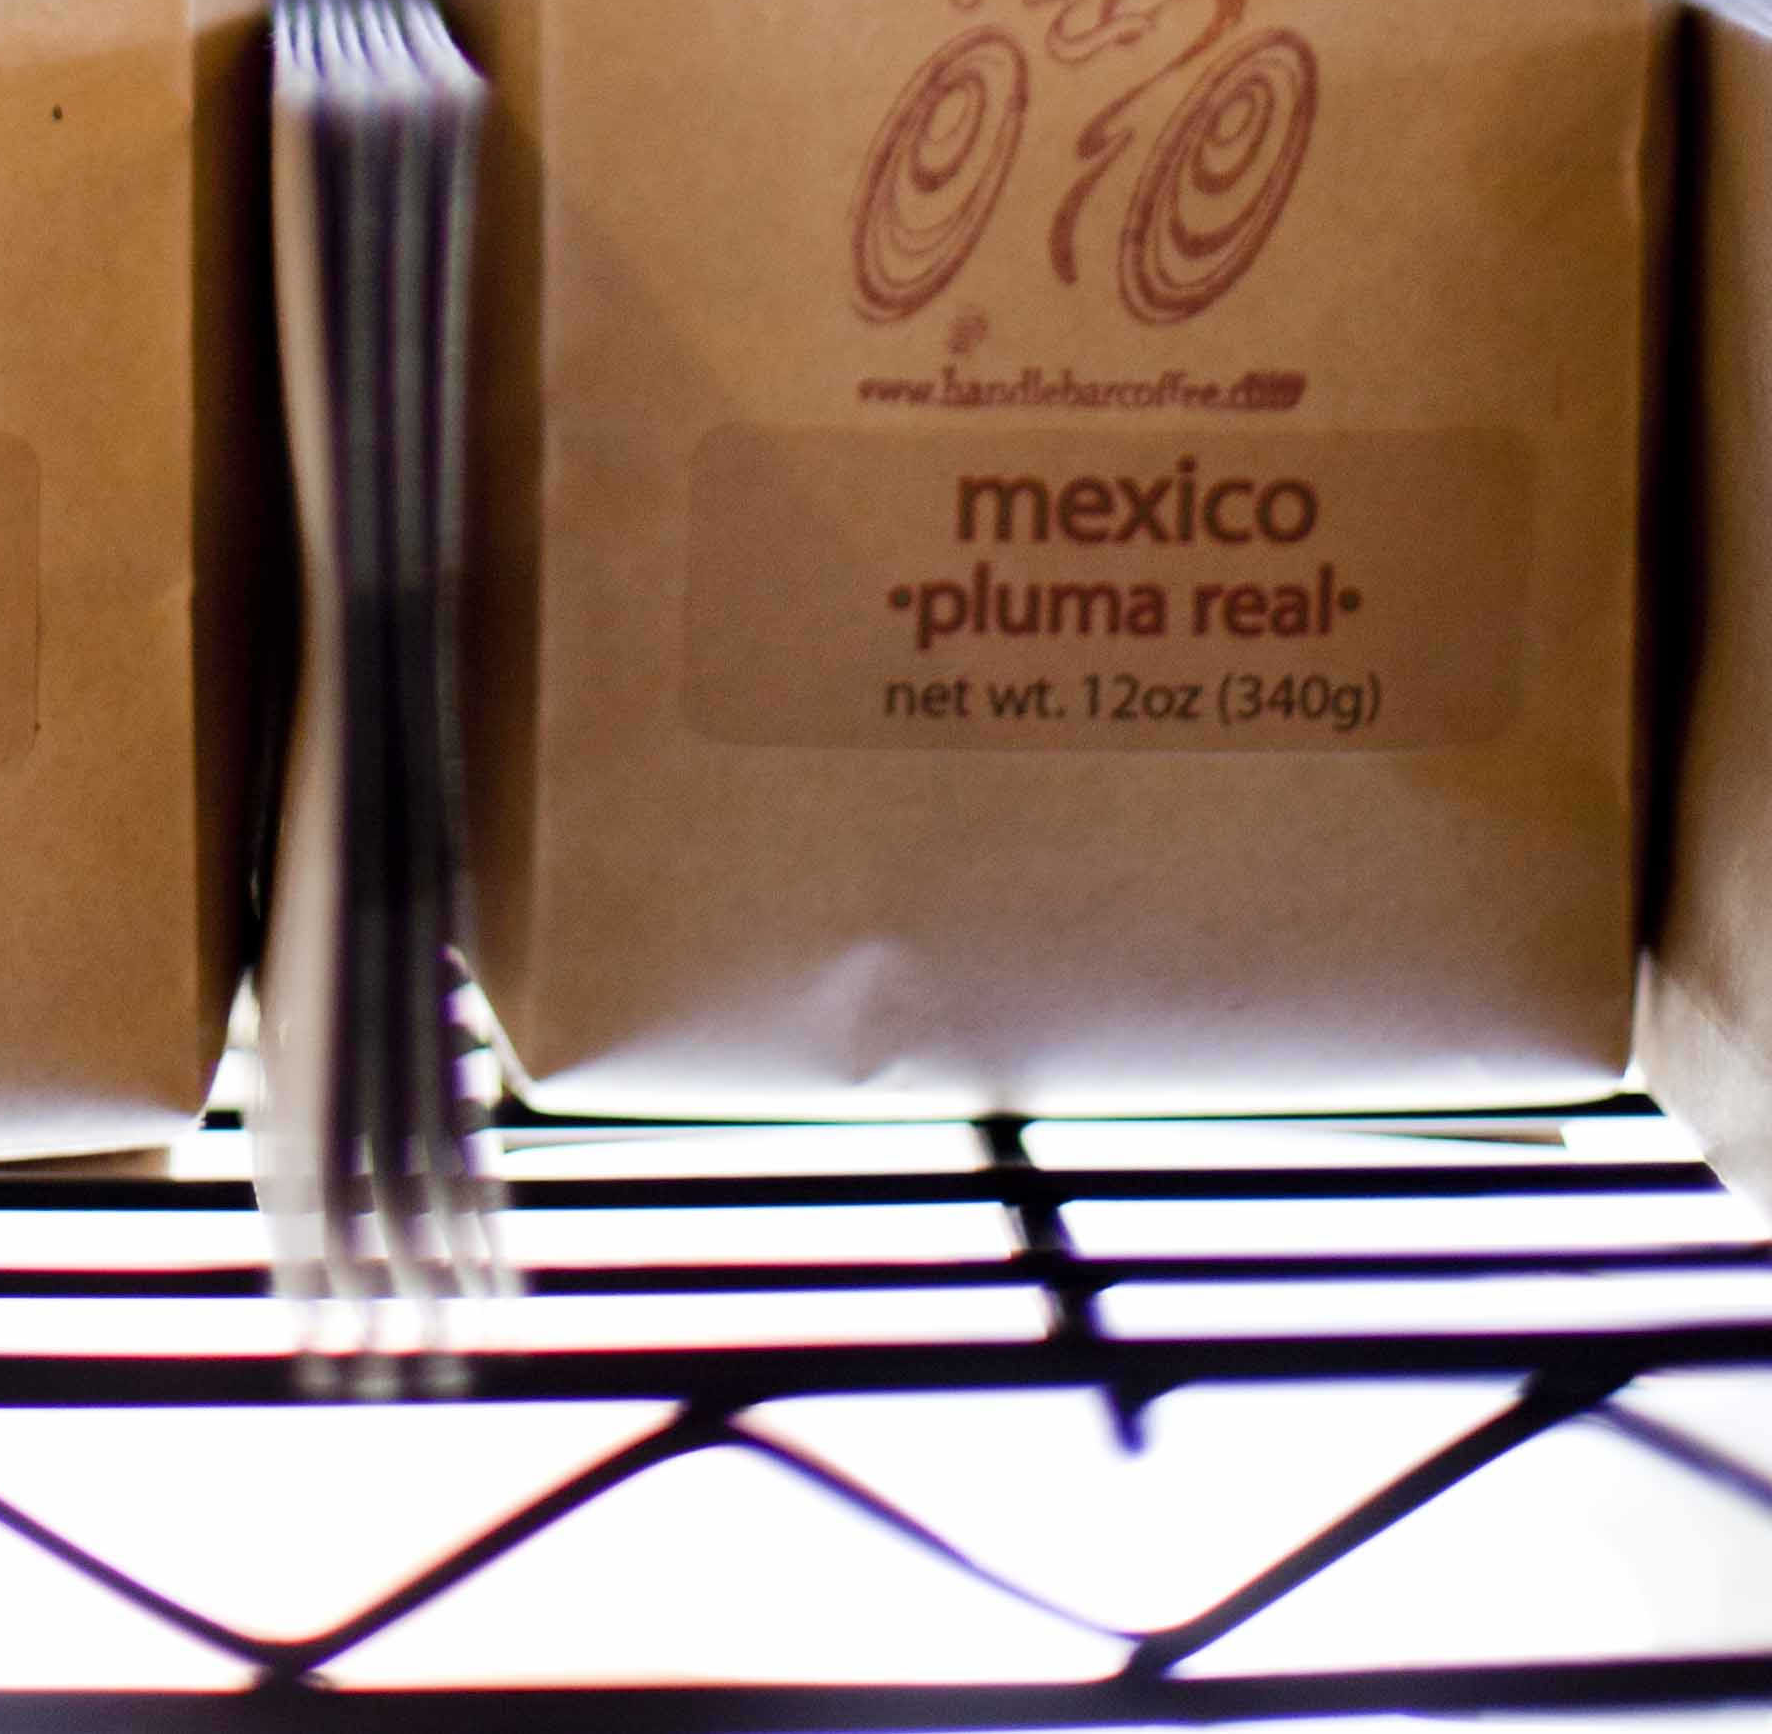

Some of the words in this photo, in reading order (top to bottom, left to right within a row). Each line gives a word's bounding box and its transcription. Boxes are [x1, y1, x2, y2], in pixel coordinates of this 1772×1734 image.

[955, 454, 1318, 545] mexico
[884, 678, 970, 719] net
[989, 681, 1065, 720] wt.
[1085, 675, 1201, 718] 12oz
[1217, 675, 1383, 731] (340g)
